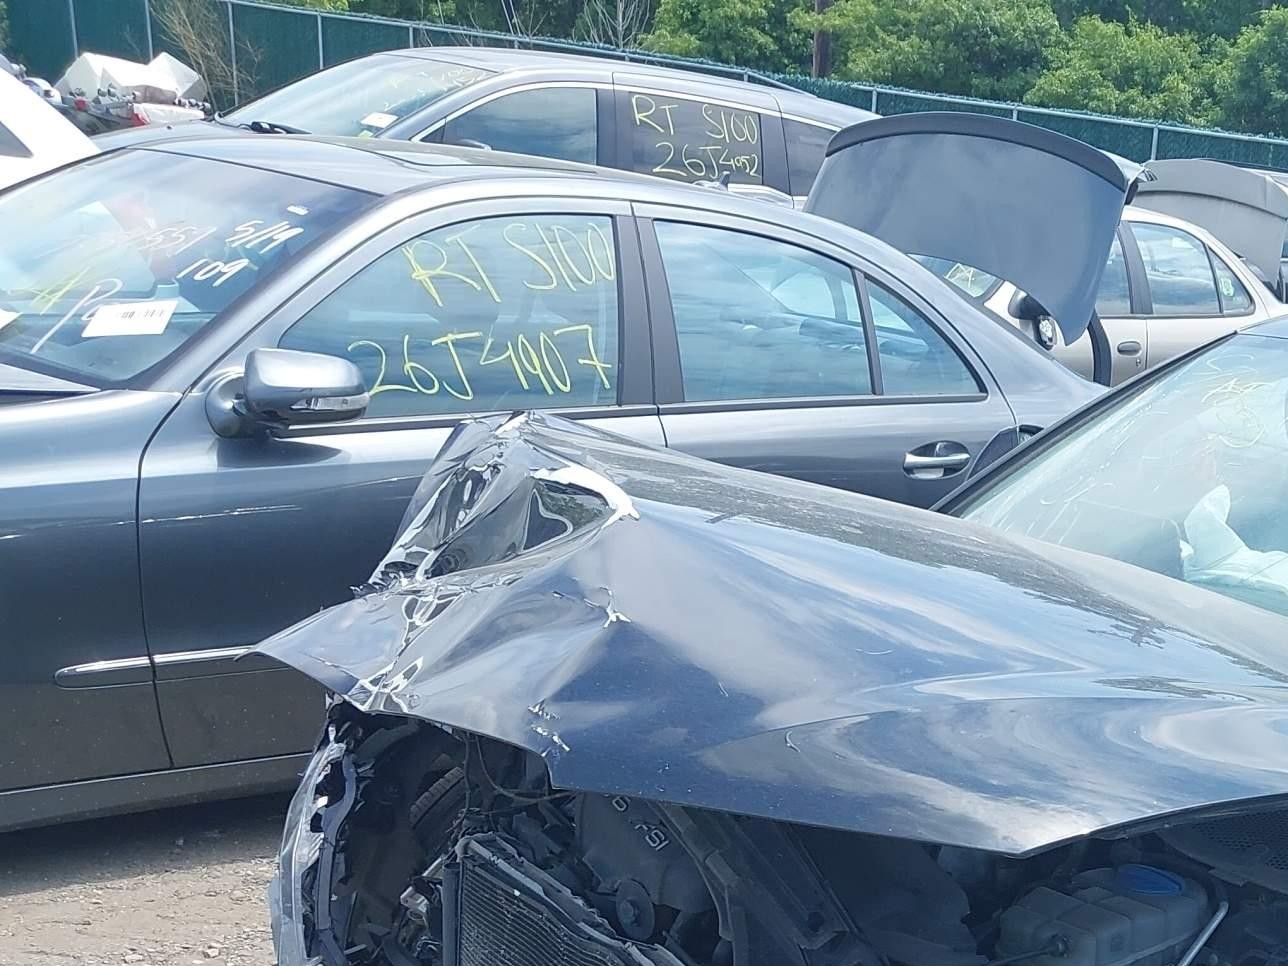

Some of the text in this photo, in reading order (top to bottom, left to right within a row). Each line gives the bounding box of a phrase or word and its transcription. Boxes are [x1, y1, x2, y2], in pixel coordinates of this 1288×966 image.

[632, 95, 679, 135] RT
[176, 257, 249, 287] 109
[401, 224, 501, 307] RT
